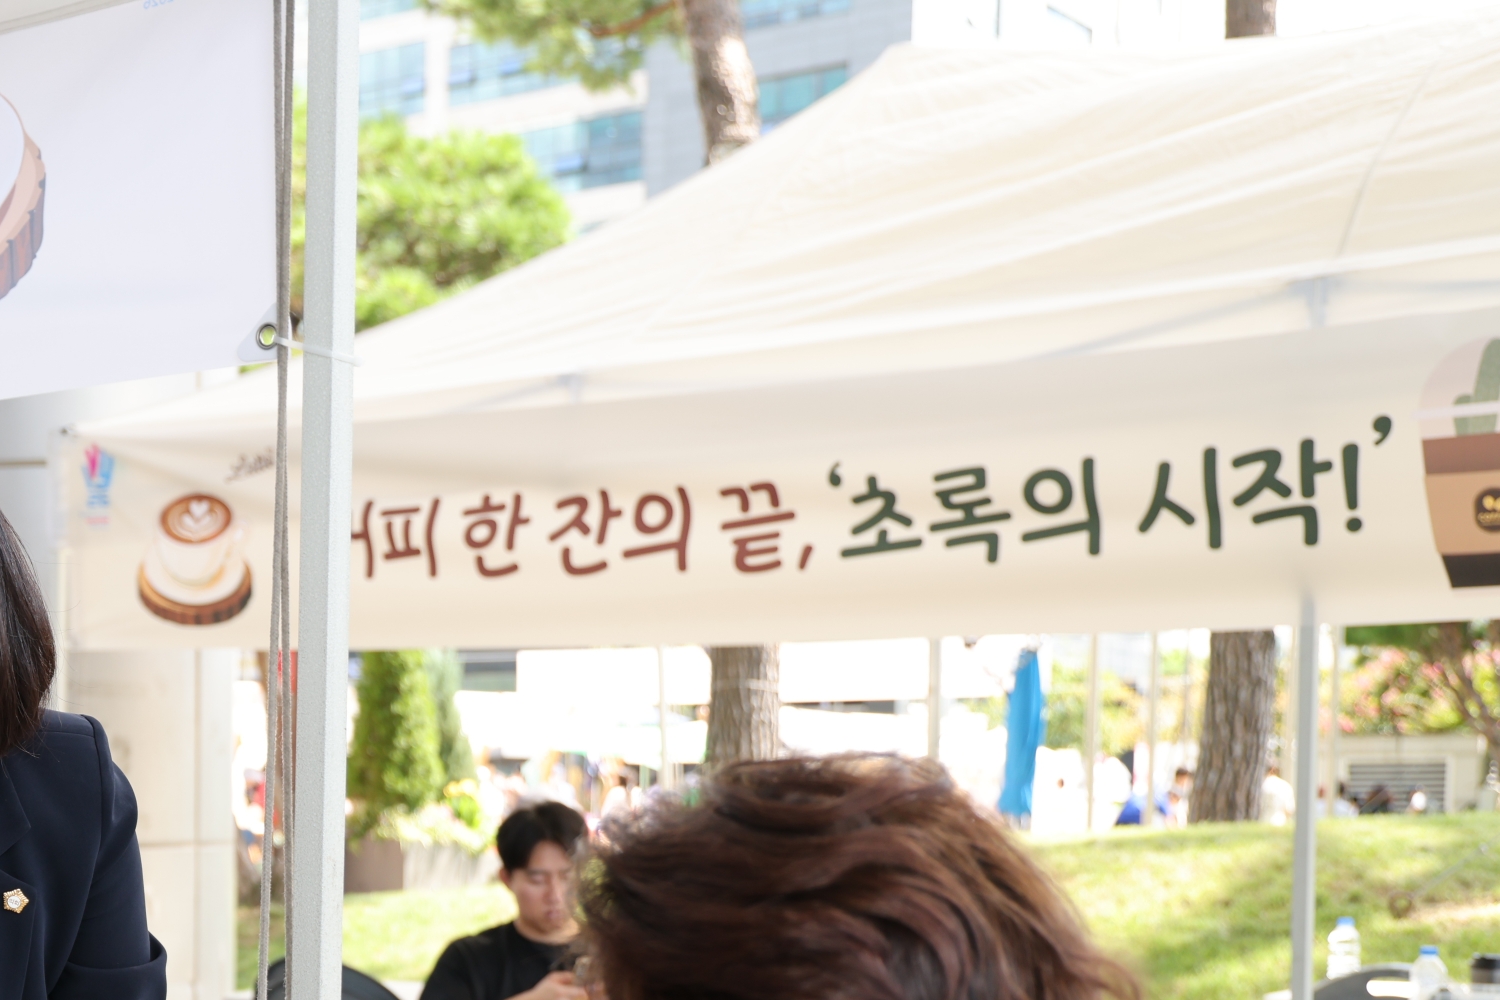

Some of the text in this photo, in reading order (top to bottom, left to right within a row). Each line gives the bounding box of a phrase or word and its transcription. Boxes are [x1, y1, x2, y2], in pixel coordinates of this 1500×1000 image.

[462, 492, 530, 578] 한
[548, 485, 693, 577] 잔의
[720, 481, 813, 573] 끝,
